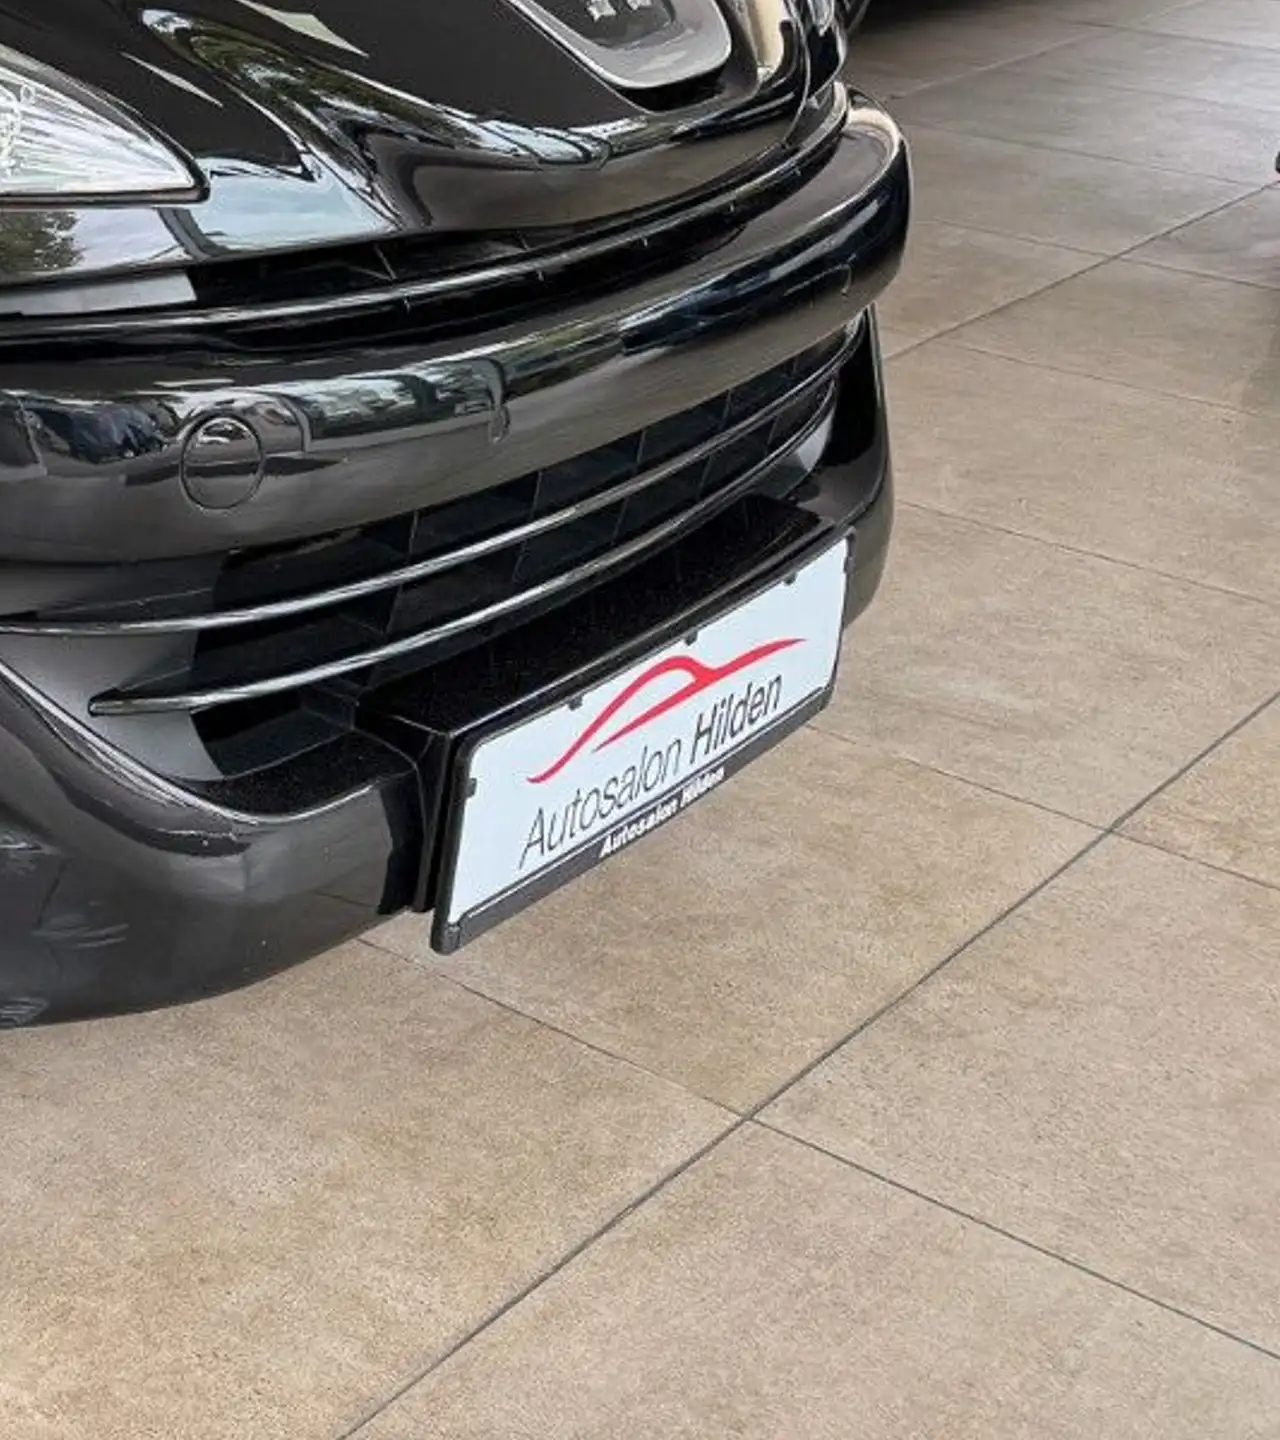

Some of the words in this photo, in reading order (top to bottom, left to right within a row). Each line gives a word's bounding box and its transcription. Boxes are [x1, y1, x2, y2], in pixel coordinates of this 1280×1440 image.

[518, 738, 683, 870] Autosalon
[689, 674, 783, 765] Hilden
[598, 797, 679, 859] Autosalon
[679, 766, 726, 810] Hilden
